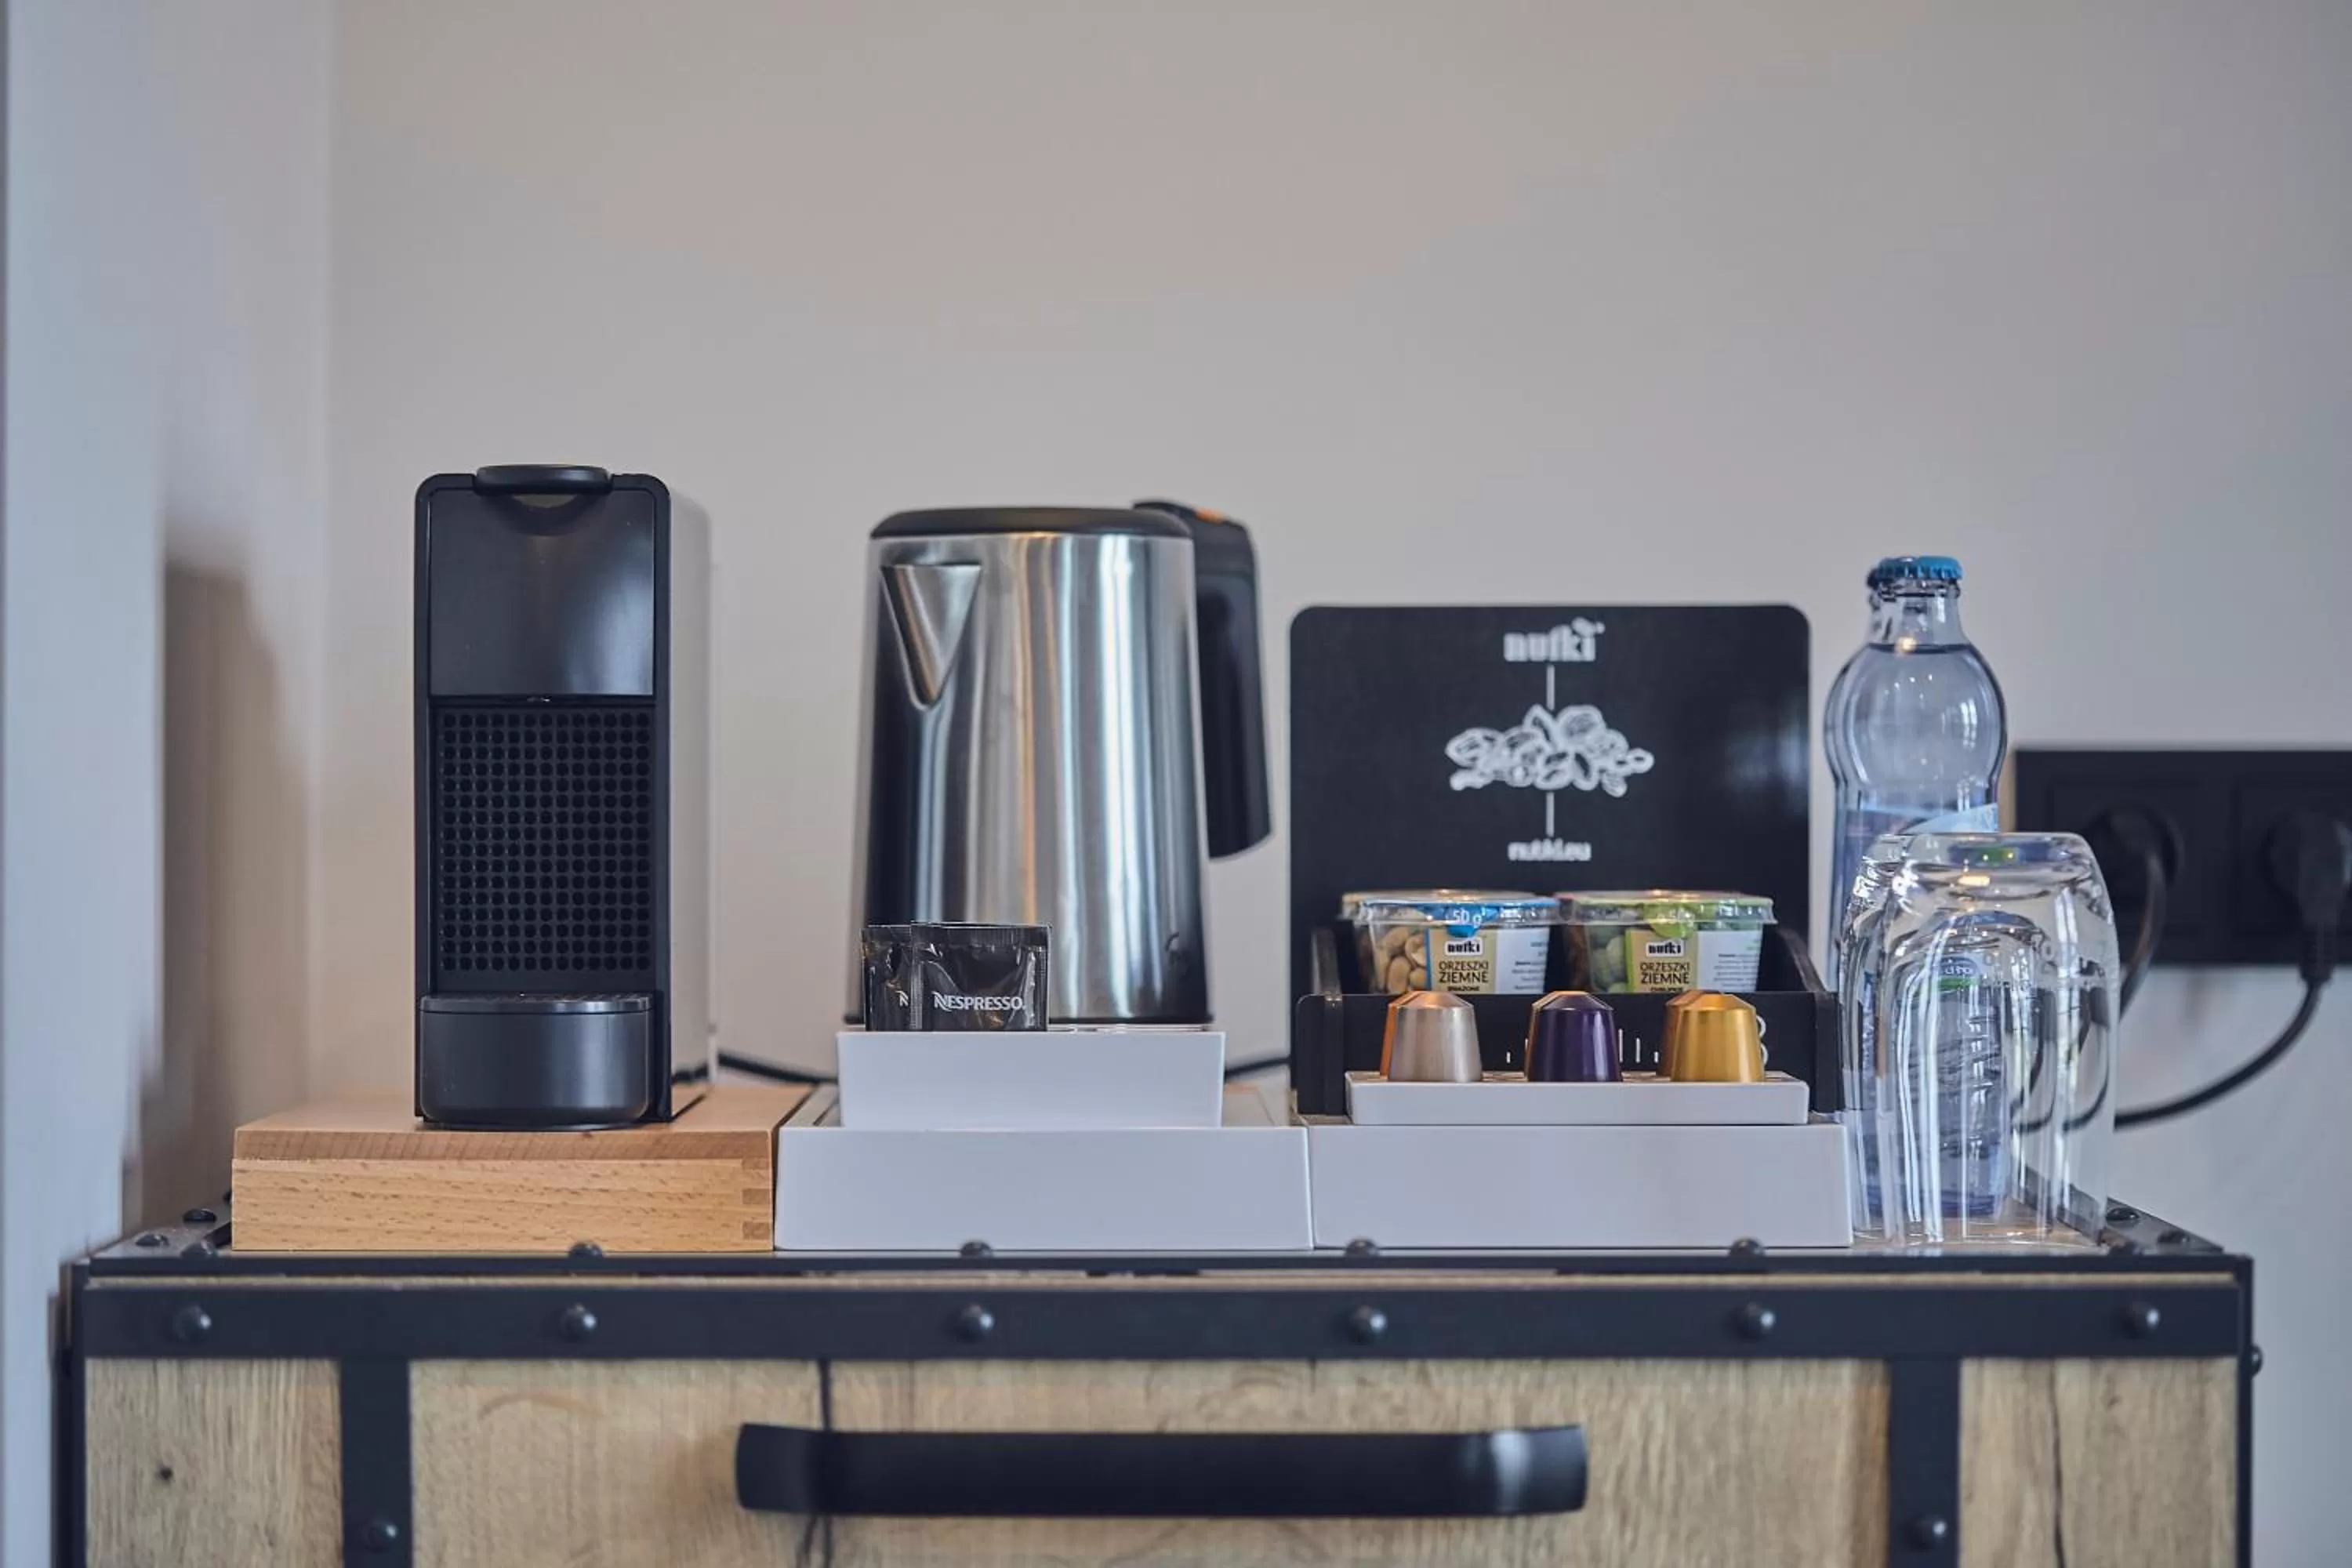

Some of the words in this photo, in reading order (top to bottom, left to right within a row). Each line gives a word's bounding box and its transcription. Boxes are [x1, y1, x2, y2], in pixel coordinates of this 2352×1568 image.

[1439, 960, 1489, 971] ORZESZKI
[1640, 962, 1690, 972] ORZESZKI
[1439, 971, 1489, 983] ZIEMNE
[1641, 972, 1690, 984] ZIEMNE
[932, 991, 1023, 1011] NESPRESSO
